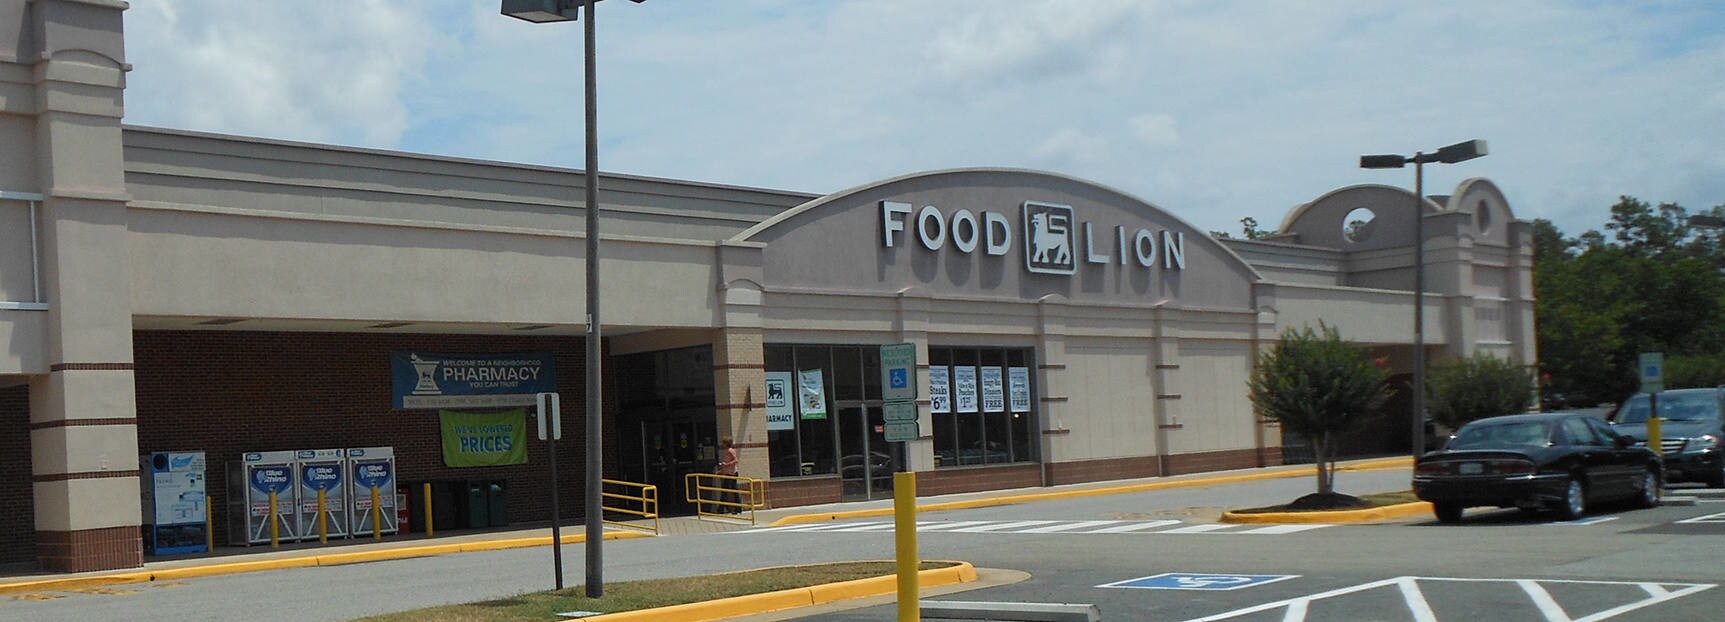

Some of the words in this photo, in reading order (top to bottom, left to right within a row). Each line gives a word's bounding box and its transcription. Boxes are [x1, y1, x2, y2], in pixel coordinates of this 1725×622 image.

[879, 200, 1012, 256] FOOD
[1083, 221, 1185, 270] LION
[443, 366, 540, 381] PHARMACY
[929, 385, 947, 395] Steaks
[985, 399, 1002, 408] FREE
[766, 414, 792, 423] ARMACY
[460, 436, 513, 453] PRICES
